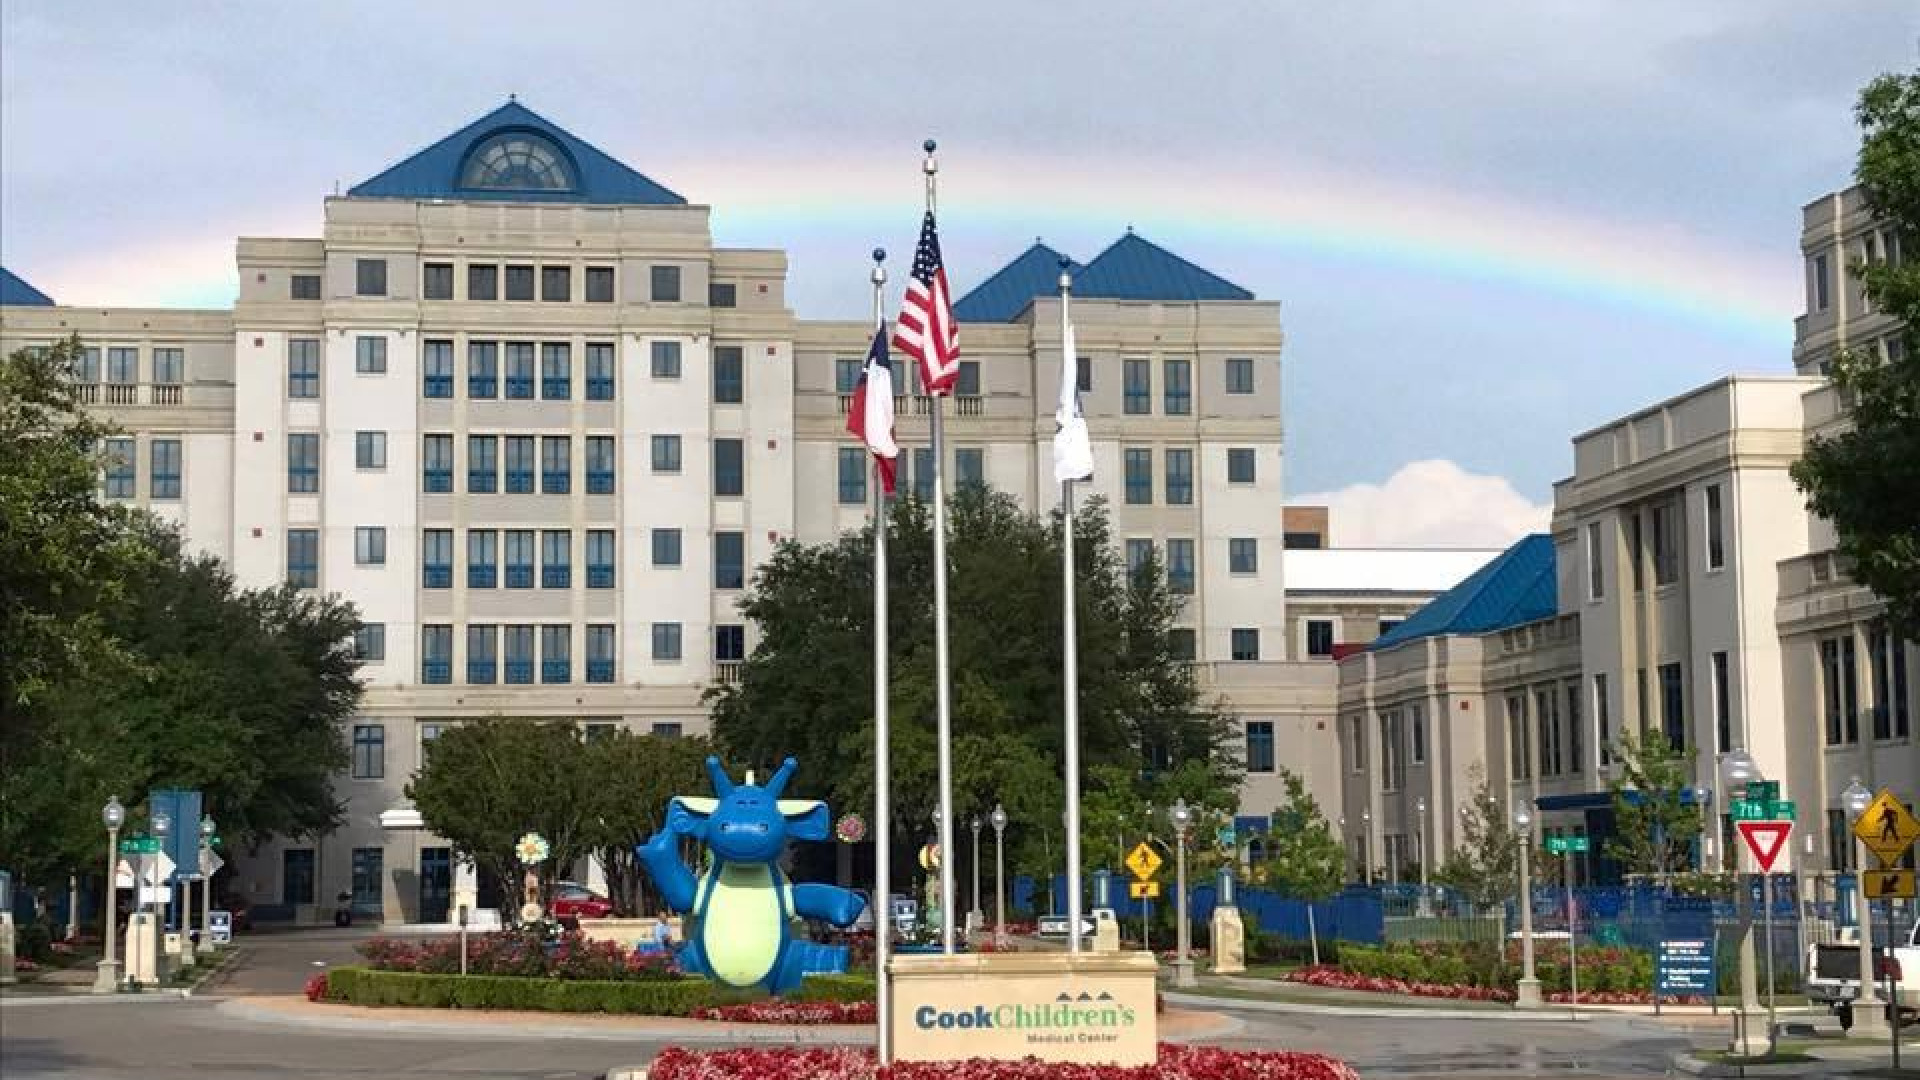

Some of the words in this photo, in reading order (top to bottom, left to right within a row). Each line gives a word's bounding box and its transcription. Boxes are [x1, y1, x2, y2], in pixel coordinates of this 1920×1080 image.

[1738, 802, 1763, 818] 7th
[1027, 1033, 1075, 1044] Medical
[1077, 1032, 1119, 1043] Center
